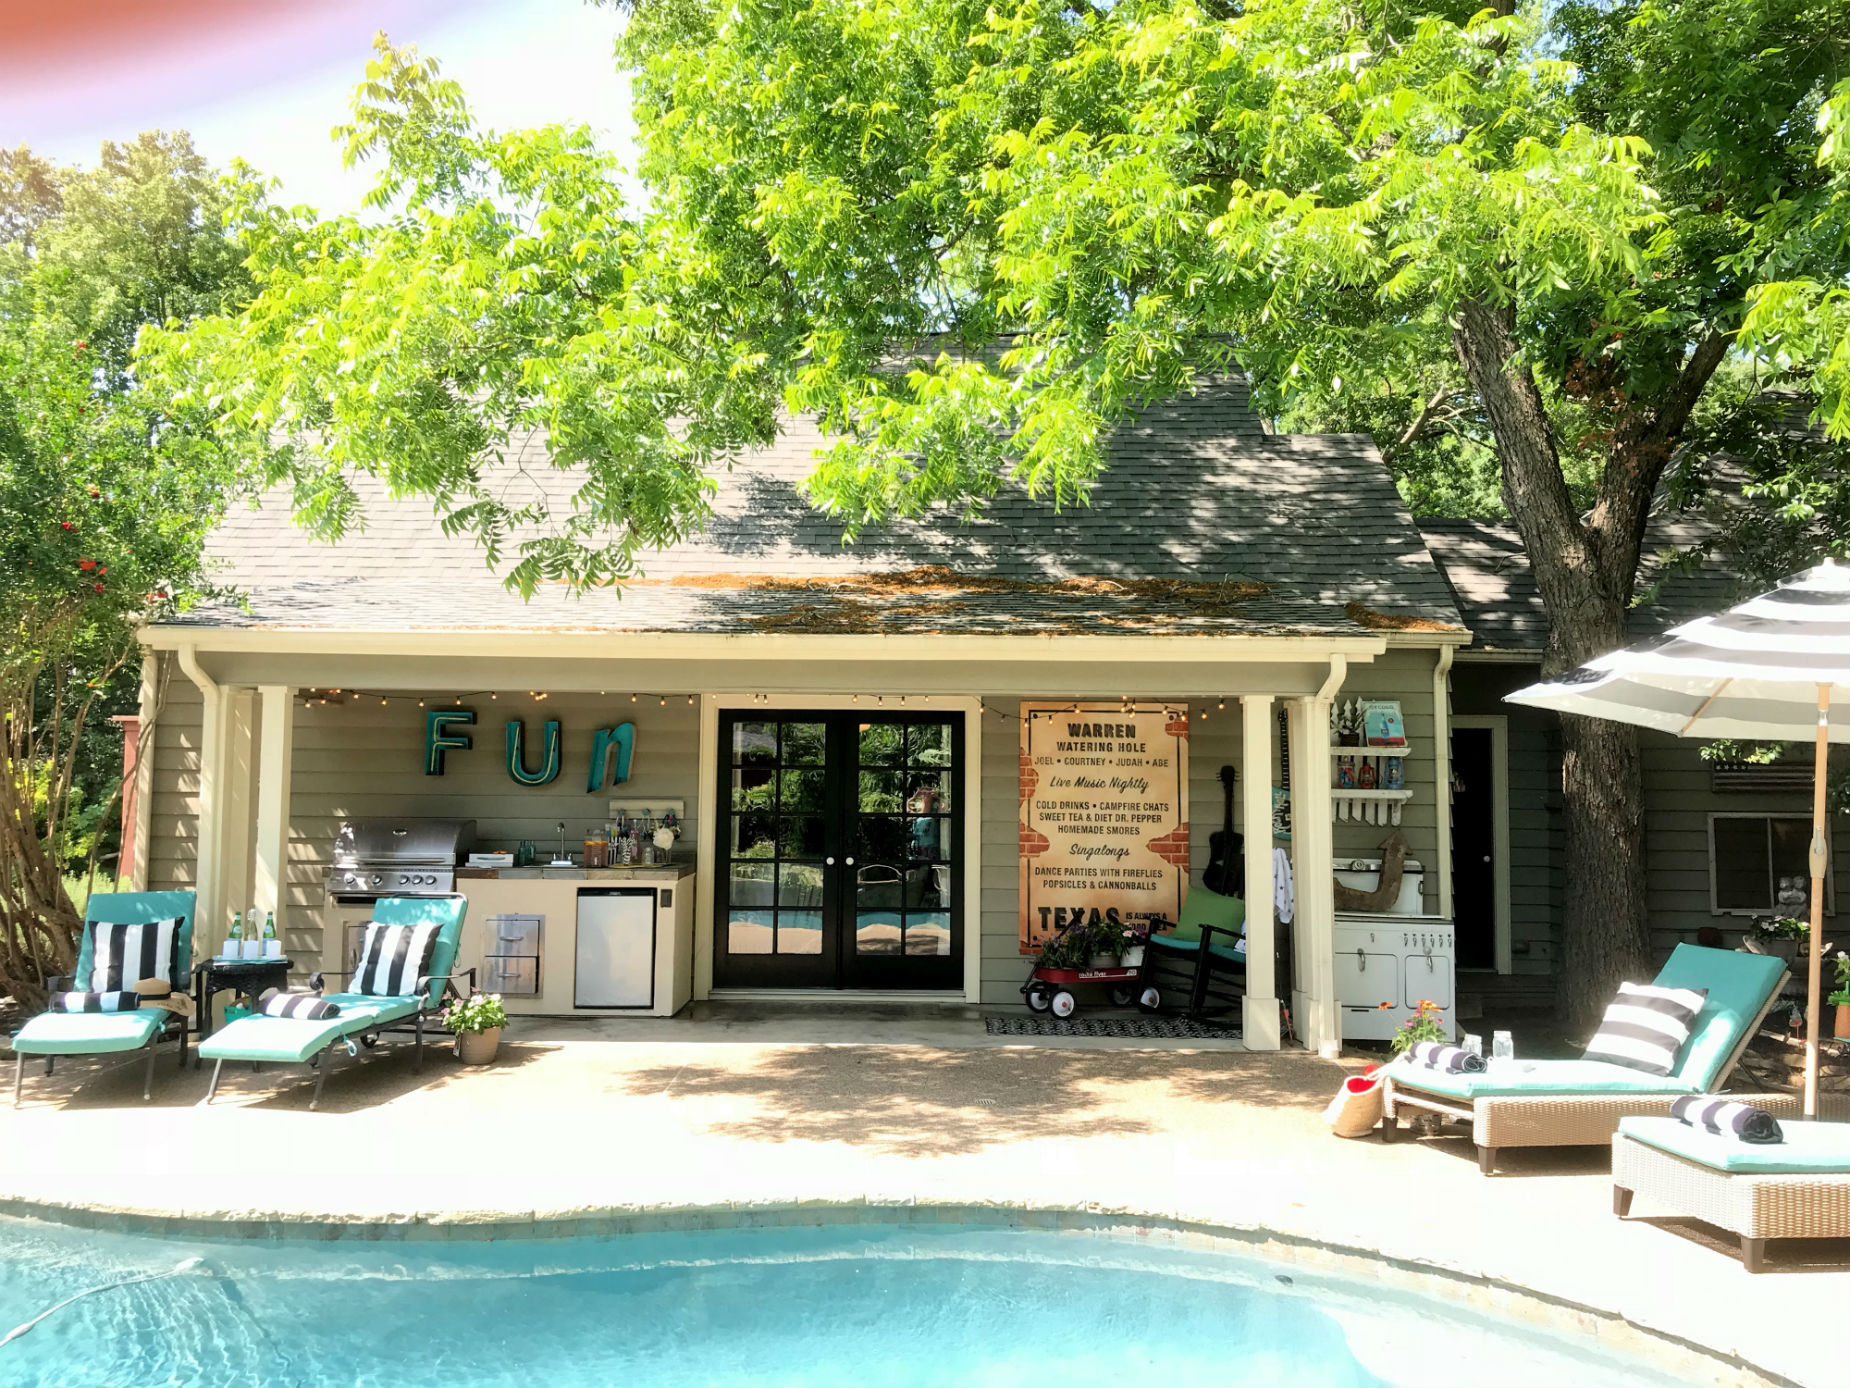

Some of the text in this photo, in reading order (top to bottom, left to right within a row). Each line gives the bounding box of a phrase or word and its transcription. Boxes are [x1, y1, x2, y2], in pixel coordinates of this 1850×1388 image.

[1067, 722, 1136, 739] WARREN
[1056, 741, 1146, 753] WATERING HOLE
[1034, 757, 1169, 767] JOEL COURTNEY JUDAH ABE
[1050, 776, 1149, 794] Live Music Nightly
[1036, 800, 1169, 812] COLD DRINKS CAMPFIRE CHATS
[1040, 812, 1162, 824] SWEET TEA & DIET DR. PEPPER
[1058, 825, 1141, 835] HOMEMADE SMORES
[1069, 843, 1130, 862] Singalongs
[1035, 867, 1163, 878] DANCE PARTIES WITH FIREFLIES
[1043, 880, 1157, 891] POPSICLES & CANNONBALLS
[1037, 906, 1120, 931] TEXAS
[1125, 912, 1133, 920] IS
[1162, 912, 1168, 920] A
